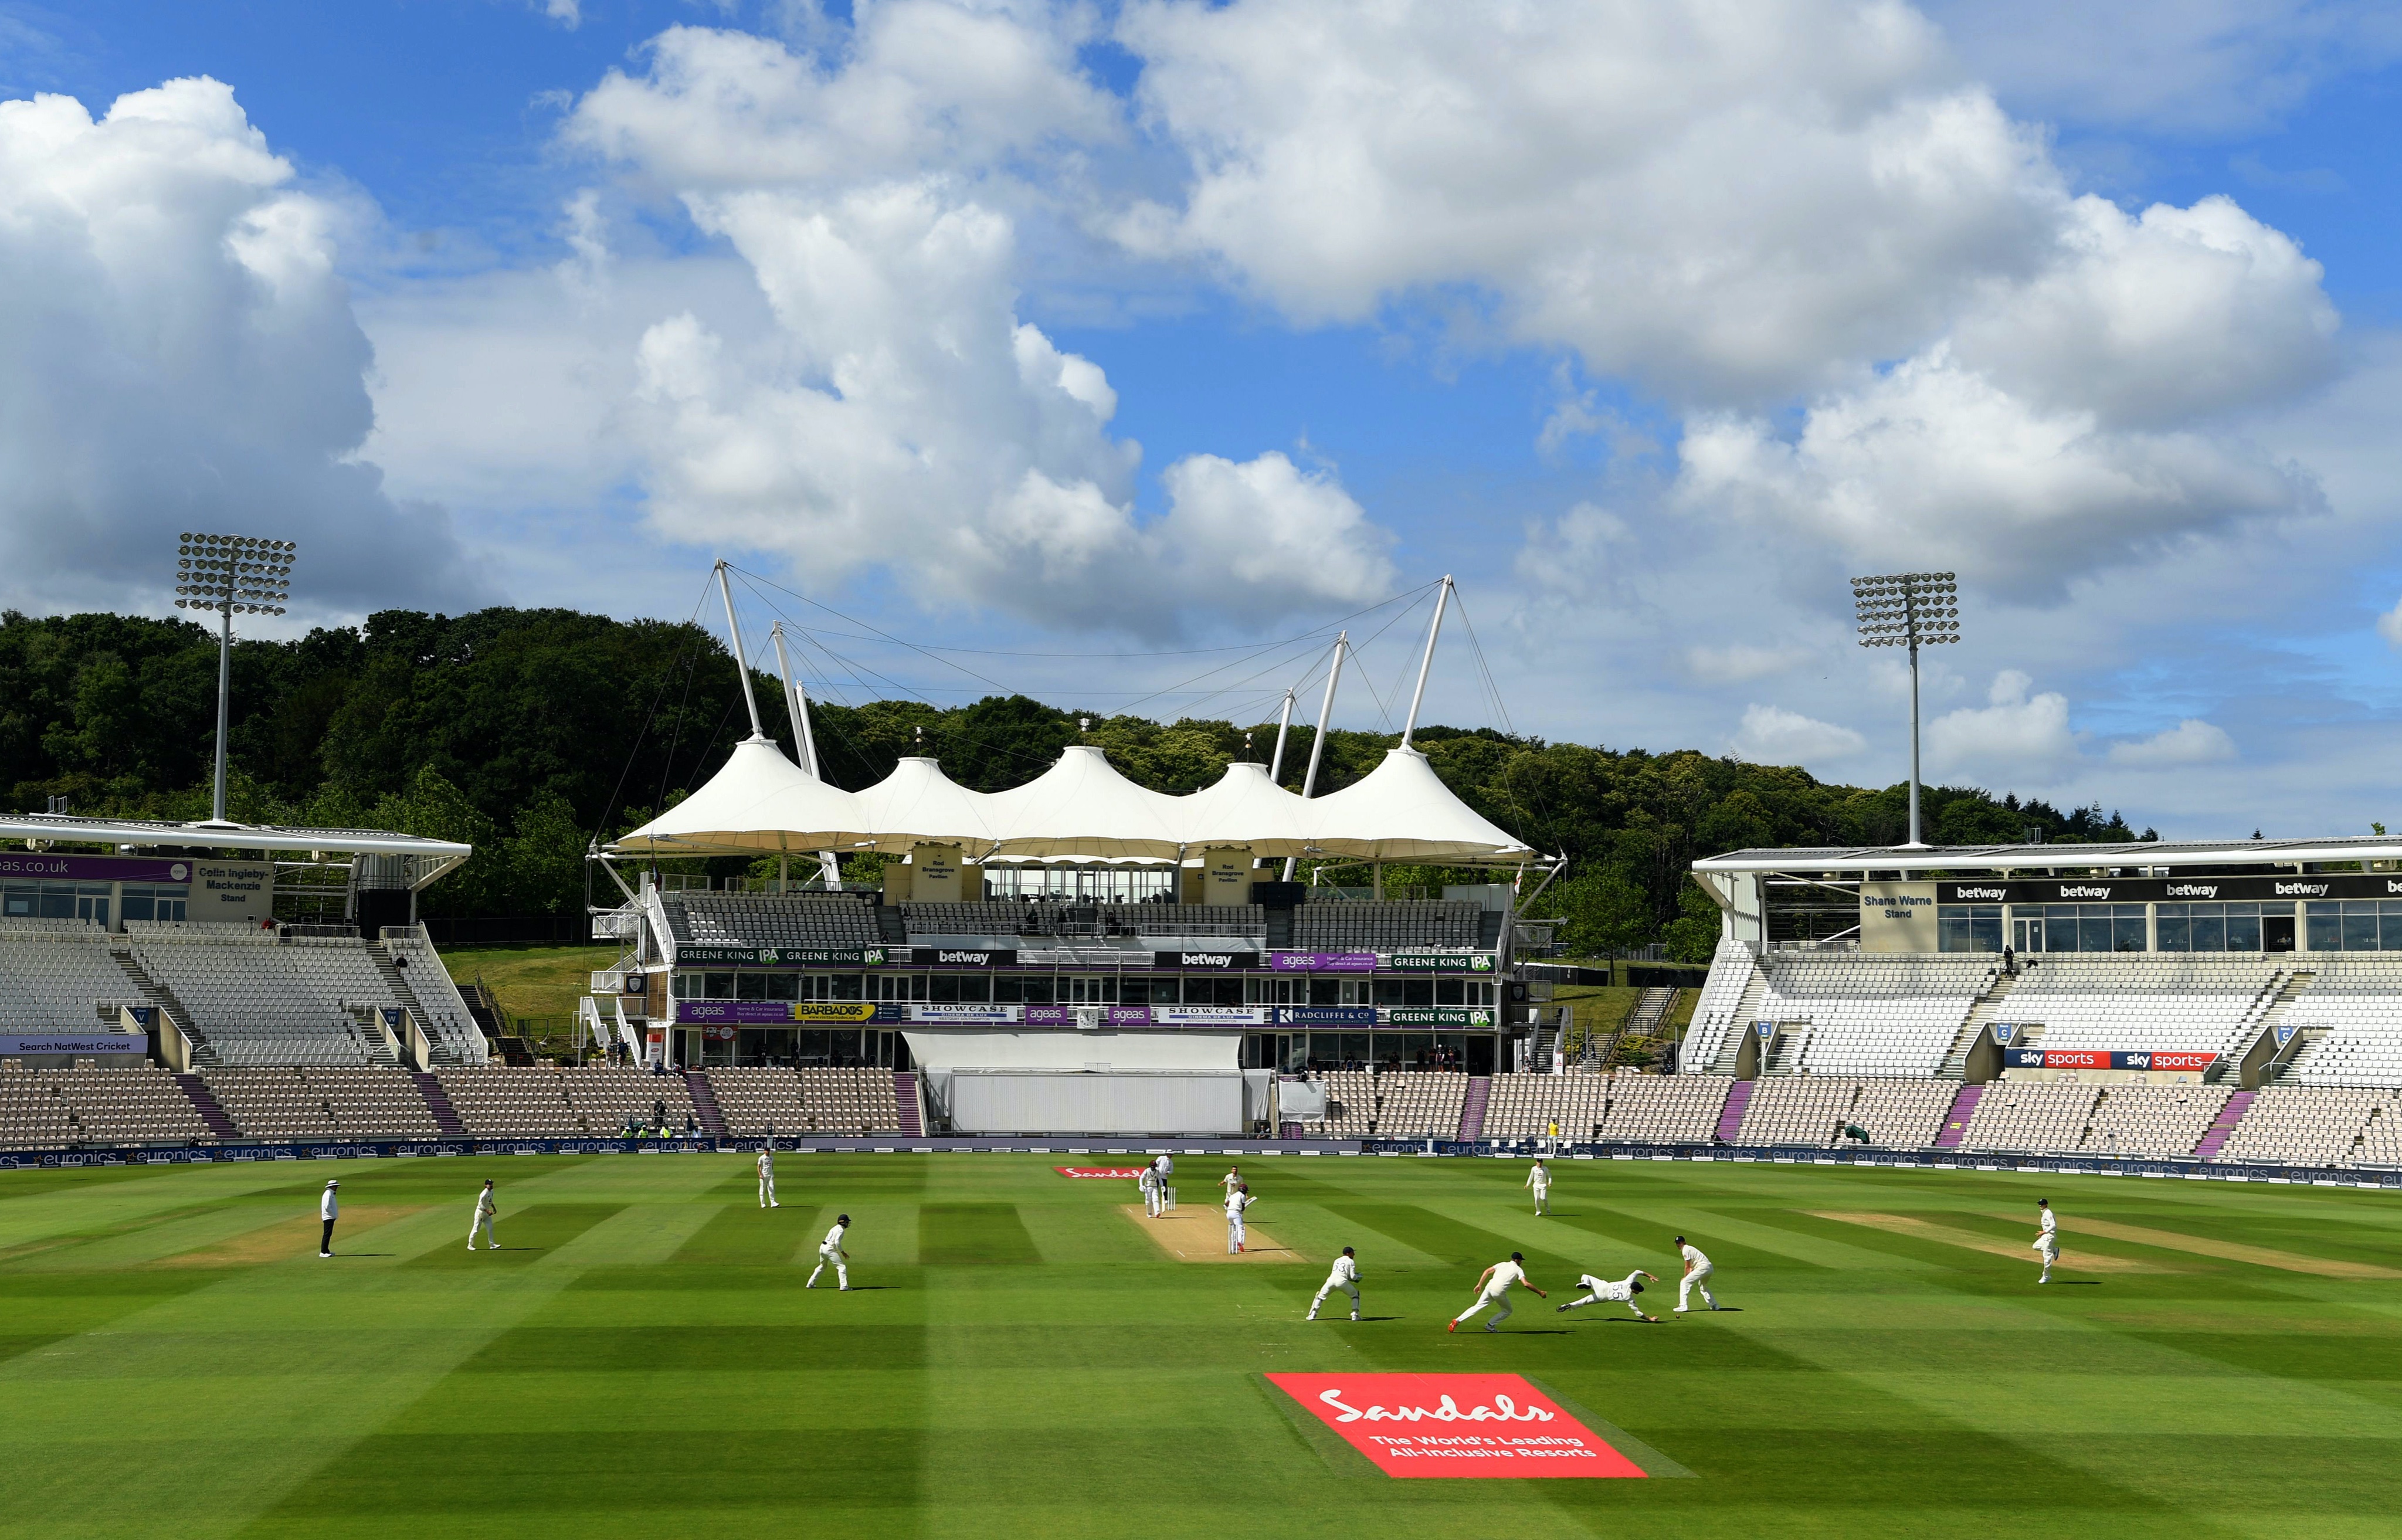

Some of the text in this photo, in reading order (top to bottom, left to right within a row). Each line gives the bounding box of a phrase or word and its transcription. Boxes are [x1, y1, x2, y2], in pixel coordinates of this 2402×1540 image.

[0, 860, 68, 873] as.co.uk
[199, 868, 269, 880] Colin Ingleby-
[206, 880, 260, 890] Mackenzie
[2167, 884, 2218, 898] betway
[2275, 882, 2329, 897] betway
[1957, 886, 2006, 901] betway
[2060, 886, 2111, 900] betway
[1864, 896, 1932, 905] Shane Warne
[1885, 910, 1912, 918] Stand
[681, 949, 779, 962] GREENE KING IPA
[787, 949, 884, 963] GREENE KING IPA
[939, 950, 989, 965] betway
[1182, 953, 1232, 968] betway
[1283, 956, 1315, 968] ageas
[1395, 955, 1491, 969] GREENE KING IPA
[691, 1006, 724, 1018] ageas
[801, 1005, 863, 1015] BARBADOS
[1030, 1009, 1061, 1021] ageas
[1113, 1010, 1144, 1022] ageas
[1393, 1011, 1490, 1025] GREENE KING IPA
[19, 1042, 130, 1051] Search NatWest Cricket
[2020, 1051, 2094, 1066] sky sports
[2126, 1053, 2201, 1068] sky sports
[311, 1144, 376, 1156] euronics
[398, 1142, 463, 1154] euronics
[481, 1140, 545, 1151] euronics
[562, 1139, 626, 1151] euronics
[1372, 1142, 1426, 1152] euronic
[1612, 1146, 1674, 1156] euronics
[137, 1148, 206, 1161] euronics
[223, 1146, 292, 1159] euronics
[1693, 1148, 1756, 1158] euronics
[1773, 1149, 1836, 1161] euronics
[1855, 1153, 1921, 1164] euronics
[1942, 1155, 2007, 1168] euronics
[2027, 1159, 2093, 1170] euronics
[2111, 1162, 2179, 1174] euronics
[2199, 1166, 2268, 1179] euronics
[2291, 1170, 2362, 1183] euronics
[1612, 1284, 1623, 1298] 55
[1319, 1389, 1554, 1422] Sandals
[1369, 1436, 1584, 1447] The World's Leading
[1389, 1448, 1597, 1457] All-Inclusive Resorts
